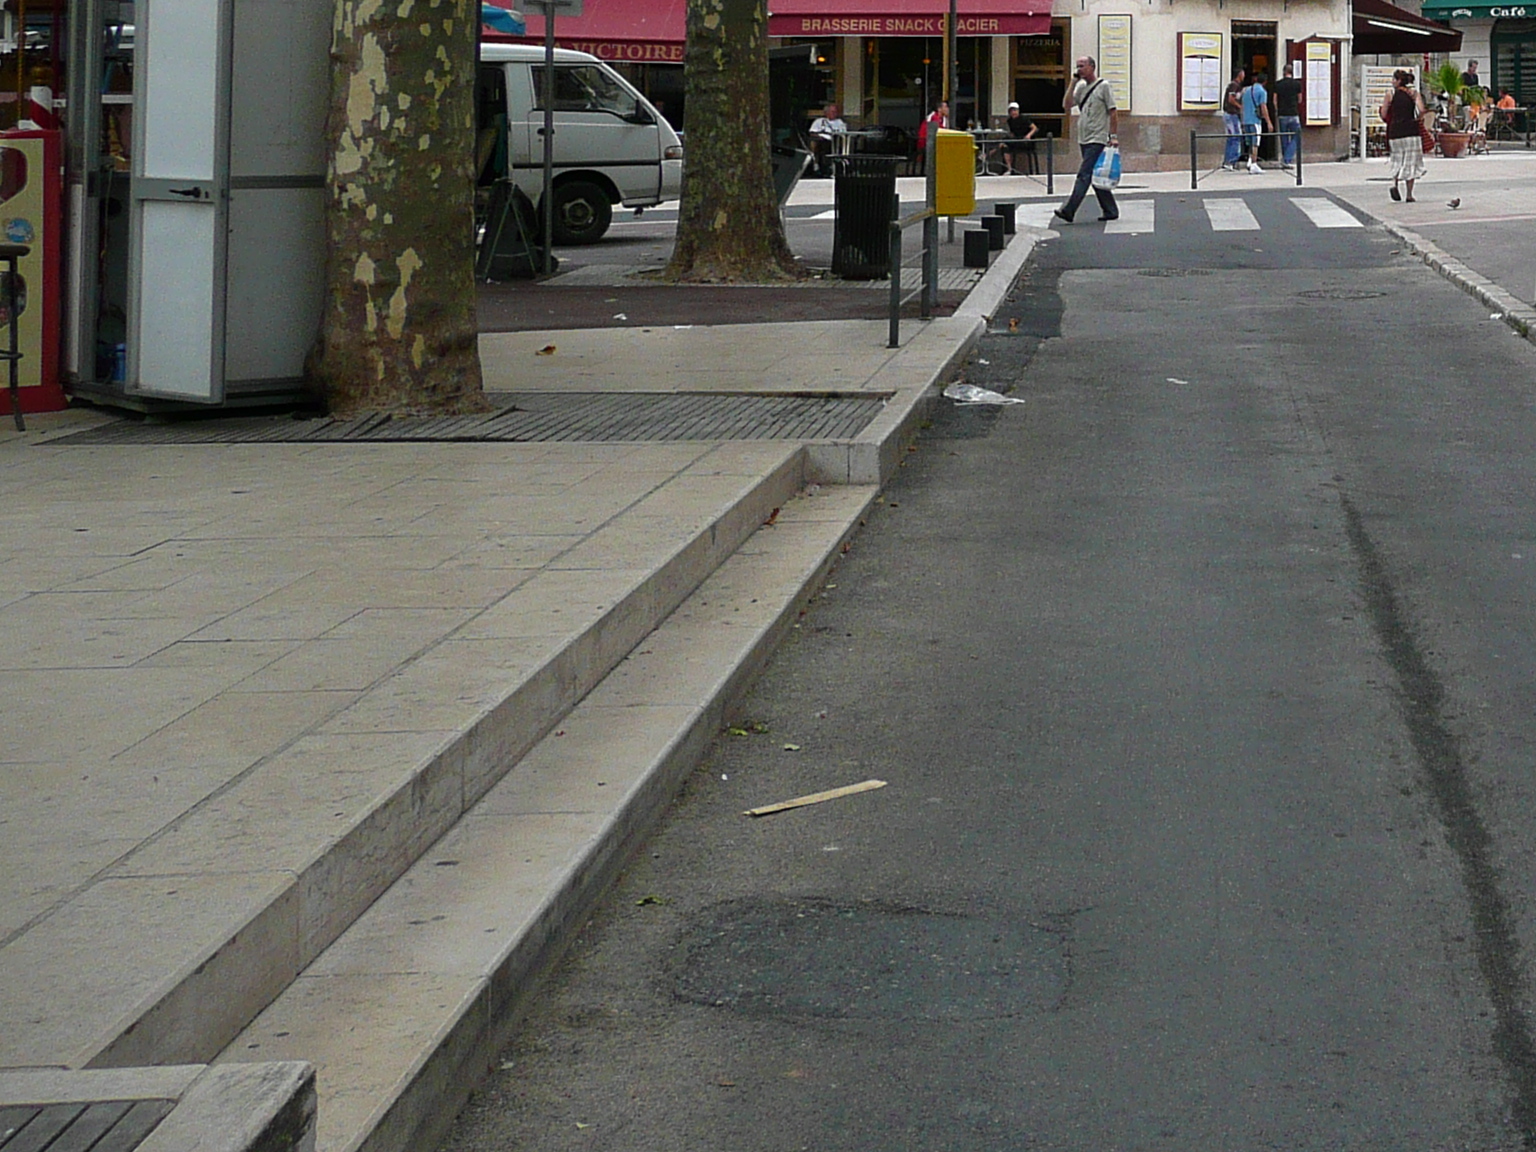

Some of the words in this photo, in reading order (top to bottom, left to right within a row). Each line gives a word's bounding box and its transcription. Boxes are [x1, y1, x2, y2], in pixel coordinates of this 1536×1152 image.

[1489, 5, 1526, 17] Café
[802, 18, 881, 31] BRASSERIE
[885, 18, 934, 32] SNACK
[938, 18, 999, 31] GACIER
